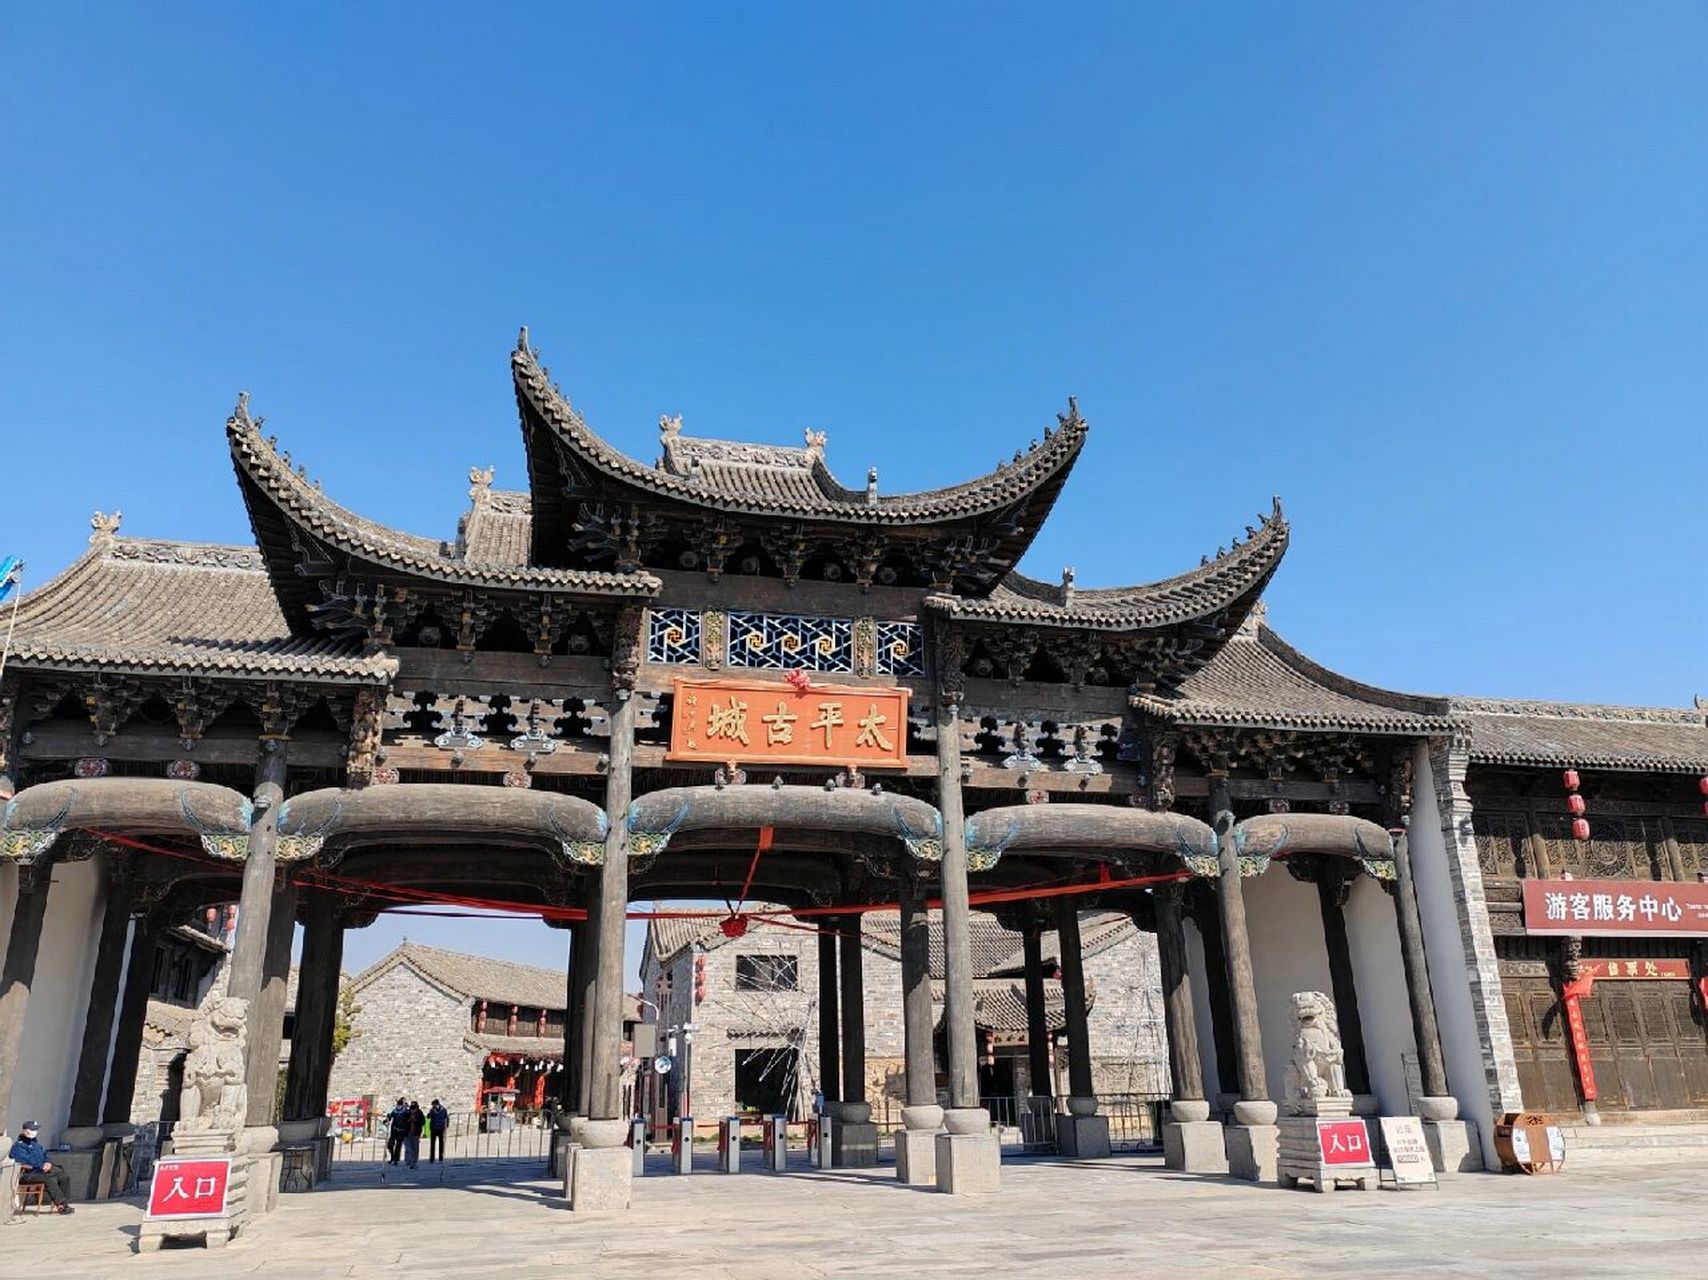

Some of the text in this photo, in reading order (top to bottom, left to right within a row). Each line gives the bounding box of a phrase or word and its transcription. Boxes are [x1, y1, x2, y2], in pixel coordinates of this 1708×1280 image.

[1545, 892, 1682, 922] 游客服务中心
[1329, 1133, 1362, 1154] 入口
[162, 1176, 217, 1202] 入口
